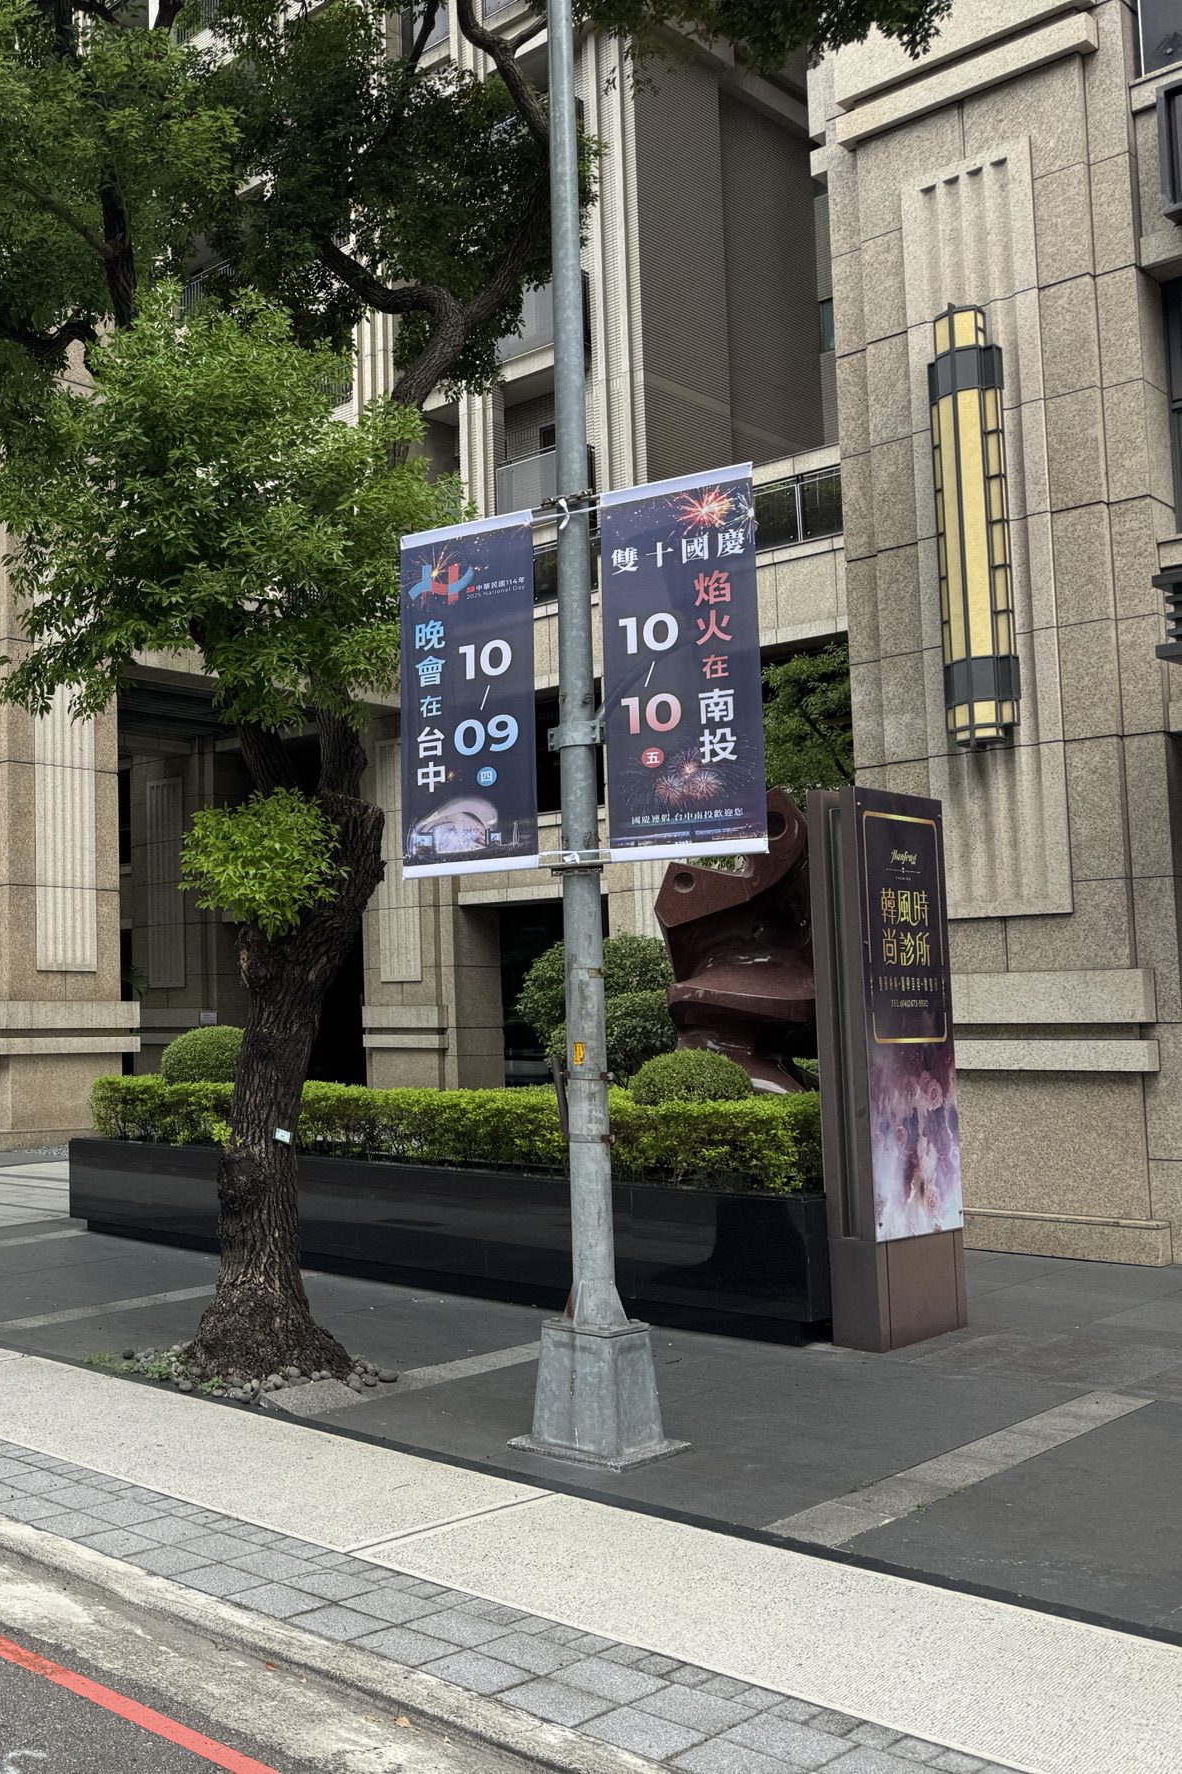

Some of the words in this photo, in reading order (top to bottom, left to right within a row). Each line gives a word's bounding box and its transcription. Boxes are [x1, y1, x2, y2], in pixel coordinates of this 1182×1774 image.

[611, 528, 745, 576] 雙十國慶
[466, 592, 482, 600] 2025
[483, 586, 511, 596] National
[512, 583, 526, 592] Day
[475, 576, 525, 591] 中華民國114年
[618, 612, 679, 655] 10
[458, 639, 512, 680] 10
[693, 569, 738, 764] 焰火在南投
[414, 619, 446, 793] 晚會在台中
[620, 692, 682, 735] 10
[453, 713, 519, 756] 09
[480, 771, 493, 782] 四
[645, 751, 660, 765] 五
[631, 813, 670, 825] 國慶連假
[880, 887, 929, 927] 韓風時
[882, 928, 930, 967] 尚診所
